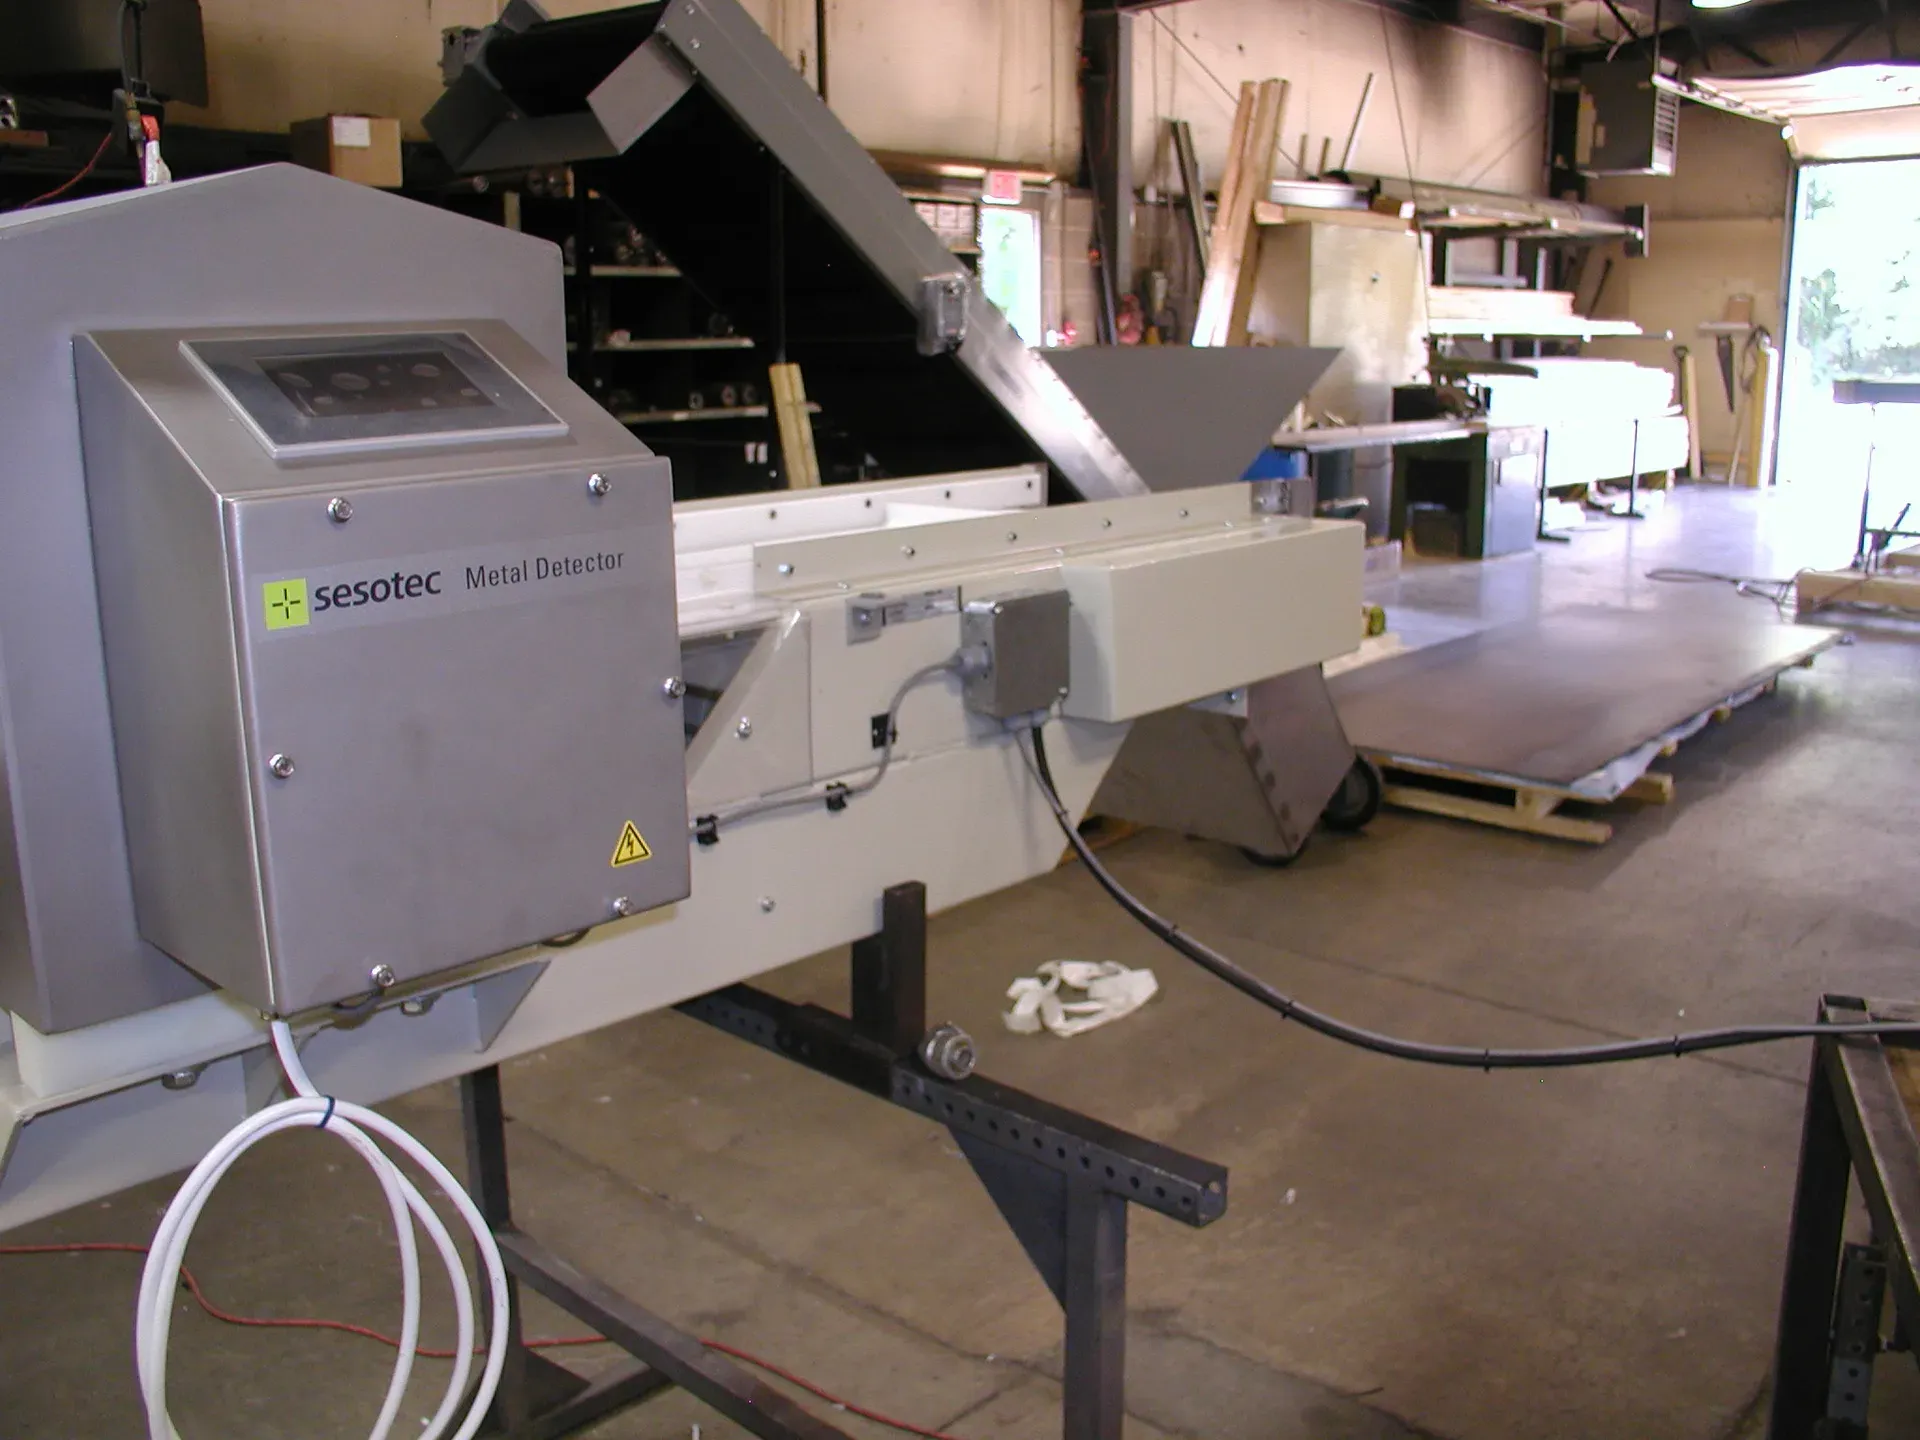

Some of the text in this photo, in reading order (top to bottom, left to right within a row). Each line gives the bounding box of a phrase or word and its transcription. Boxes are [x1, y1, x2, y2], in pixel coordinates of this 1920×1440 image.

[314, 552, 624, 611] sesotec Metal Detector
